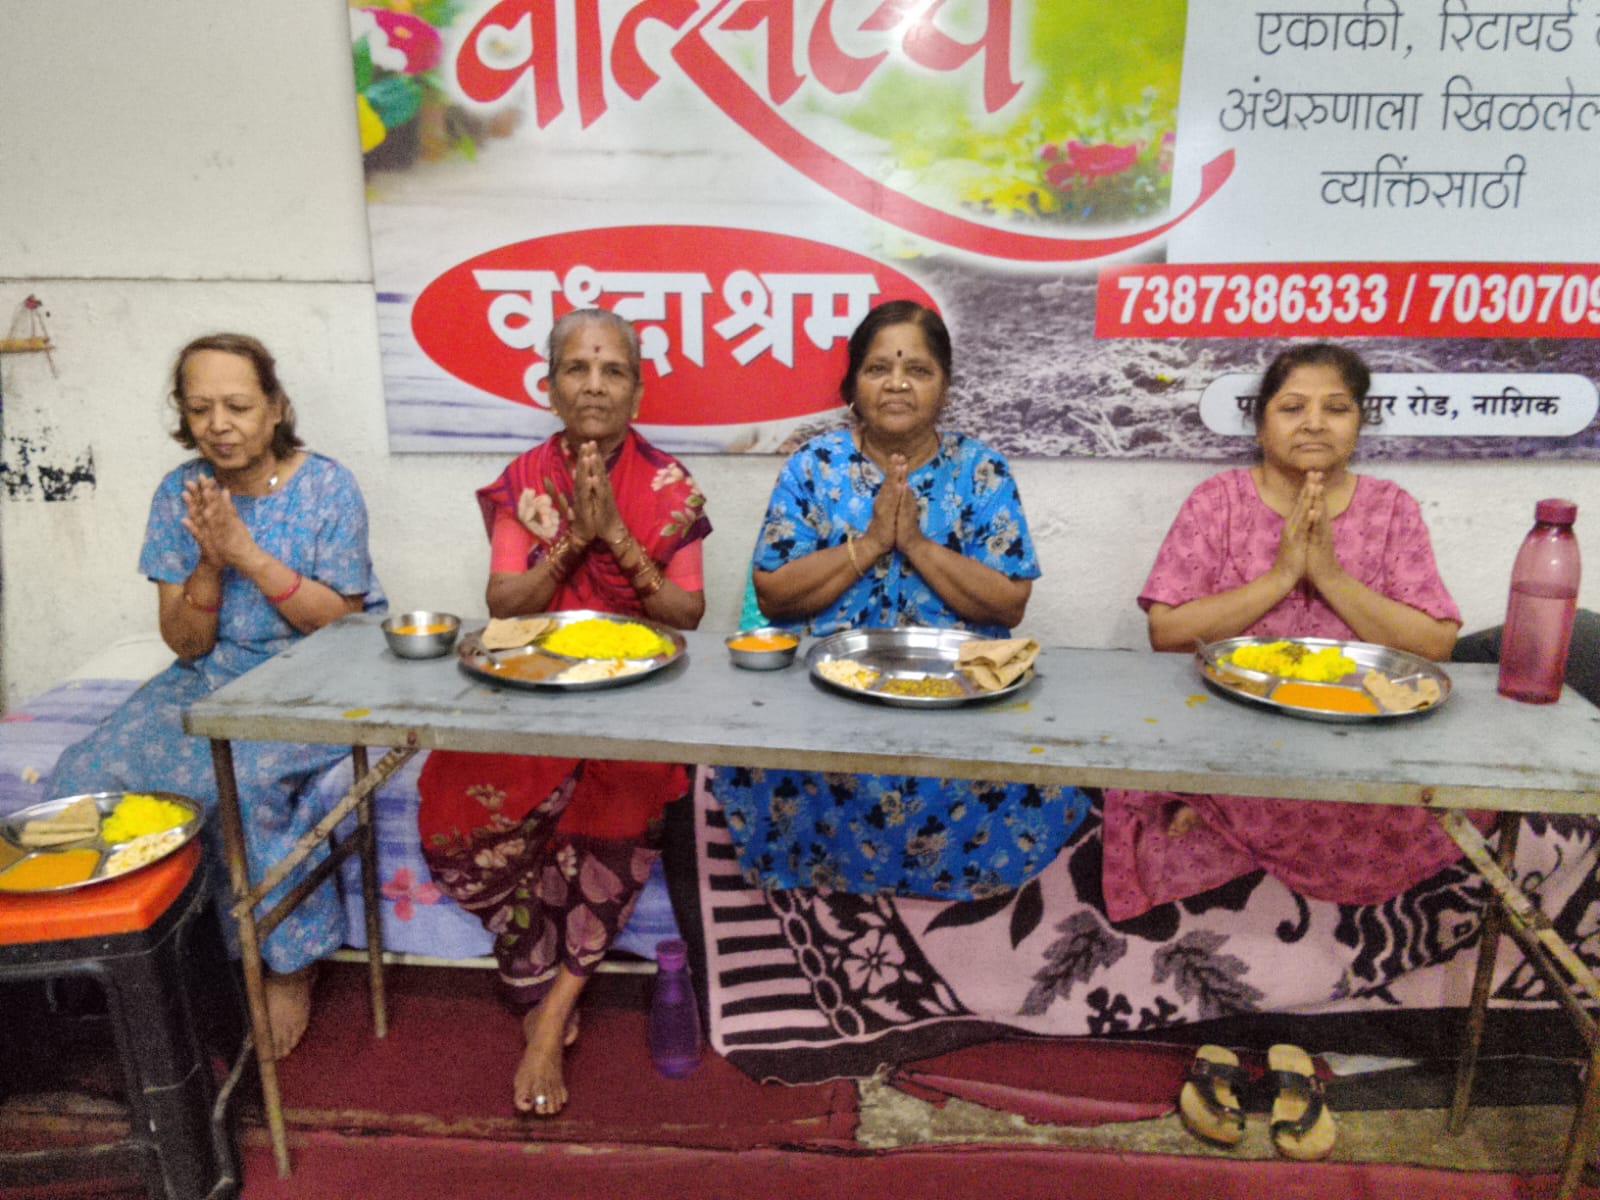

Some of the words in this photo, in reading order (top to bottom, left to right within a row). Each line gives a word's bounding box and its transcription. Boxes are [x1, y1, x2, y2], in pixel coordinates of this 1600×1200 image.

[1255, 0, 1413, 59] एकाकी,
[1438, 0, 1578, 52] रिटायर्ड
[1218, 74, 1424, 132] अंथरुणाला
[1117, 273, 1389, 325] 7387386333
[1396, 273, 1418, 324] /
[1406, 386, 1459, 421] रोड,
[1471, 386, 1562, 417] नाशिक
